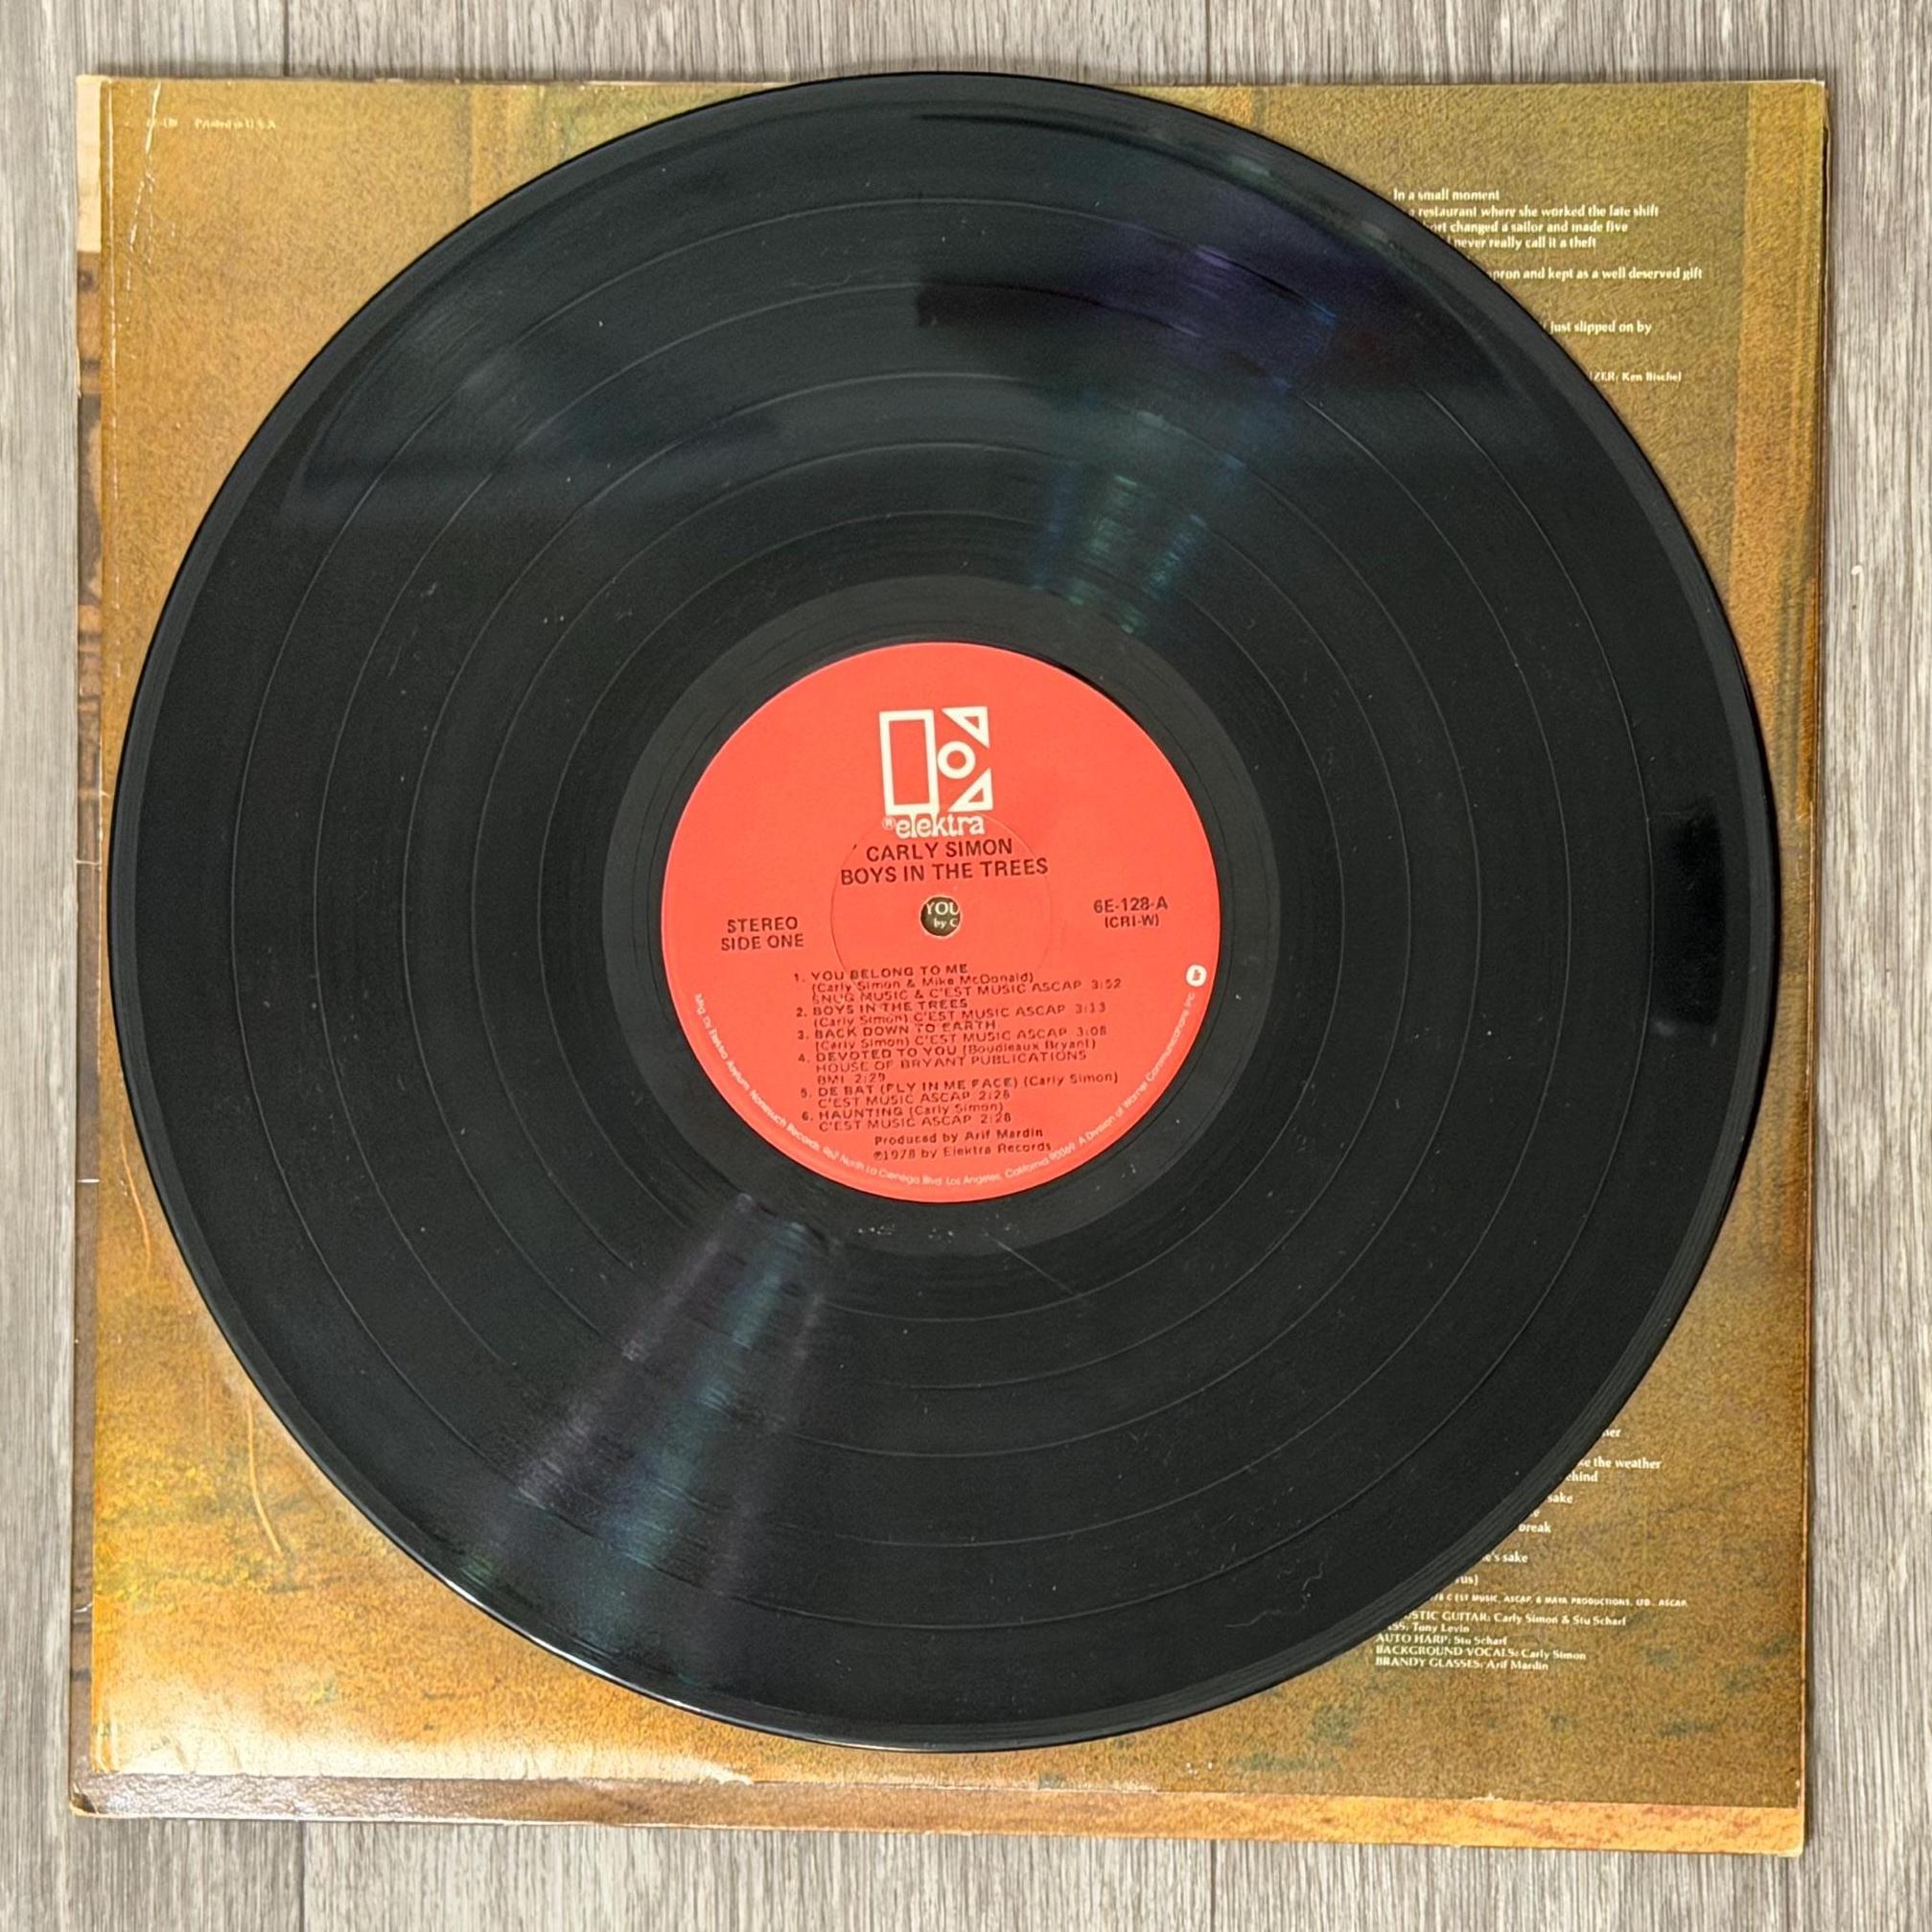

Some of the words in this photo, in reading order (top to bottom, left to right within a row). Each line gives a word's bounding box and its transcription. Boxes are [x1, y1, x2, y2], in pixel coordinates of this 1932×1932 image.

[1393, 188, 1405, 200] In
[1408, 192, 1415, 200] a
[1418, 188, 1450, 200] small
[1452, 189, 1500, 200] moment
[1418, 206, 1477, 218] restaurant
[1480, 204, 1517, 218] where
[1519, 204, 1538, 217] she
[1541, 204, 1585, 217] worked
[1588, 204, 1607, 217] the
[1609, 204, 1631, 217] late
[1633, 204, 1659, 218] shift
[1450, 221, 1499, 235] changed
[1511, 221, 1544, 232] sailor
[1547, 221, 1569, 233] and
[1571, 221, 1603, 233] made
[1606, 221, 1628, 233] five
[1454, 238, 1486, 248] never
[1489, 236, 1522, 250] really
[1525, 236, 1546, 248] call
[1548, 237, 1556, 248] it
[1559, 240, 1567, 248] a
[1569, 236, 1596, 248] theft
[1523, 267, 1545, 279] and
[1548, 267, 1573, 282] kept
[1575, 269, 1589, 279] as
[1592, 269, 1598, 279] a
[1601, 267, 1625, 279] well
[1628, 267, 1680, 279] deserved
[1683, 267, 1703, 281] gift
[1550, 321, 1571, 335] just
[1573, 320, 1616, 335] slipped
[1618, 324, 1633, 333] on
[1637, 320, 1652, 335] by
[1622, 372, 1642, 382] Ken
[896, 813, 985, 839] elektra
[866, 842, 939, 862] CARLY
[945, 838, 1013, 858] SIMON
[841, 866, 897, 885] BOYS
[903, 865, 924, 882] IN
[931, 862, 973, 880] THE
[979, 857, 1049, 875] TREES
[926, 901, 960, 916] YOU
[1093, 896, 1168, 914] 6E-128-A
[727, 917, 798, 934] STEREO
[934, 918, 947, 929] by
[1105, 913, 1159, 928] (CRI-W)
[721, 936, 761, 951] SIDE
[767, 933, 803, 948] ONE
[811, 970, 845, 982] YOU
[850, 966, 914, 980] BELONG
[920, 965, 941, 976] TO
[945, 964, 967, 974] ME
[812, 982, 851, 994] (Carly
[857, 980, 900, 991] Simon
[906, 979, 916, 988] &
[922, 977, 954, 988] Mike
[960, 972, 1034, 987] McDonald)
[860, 989, 908, 1002] MUSIC
[914, 989, 923, 999] &
[929, 986, 971, 998] C'EST
[977, 984, 1026, 996] MUSIC
[1032, 980, 1082, 992] ASCAP
[813, 1005, 854, 1016] BOYS
[860, 1003, 876, 1013] IN
[881, 1001, 913, 1013] THE
[918, 998, 968, 1011] TREES
[814, 1015, 854, 1028] (Carly
[859, 1013, 908, 1026] Simon)
[914, 1011, 956, 1022] C'EST
[962, 1007, 1010, 1020] MUSIC
[1015, 1004, 1065, 1016] ASCAP
[815, 1028, 857, 1039] BACK
[863, 1025, 909, 1036] DOWN
[915, 1023, 936, 1034] TO
[943, 1020, 996, 1032] EARTH
[816, 1039, 855, 1052] (Carly
[861, 1036, 910, 1049] Simon)
[915, 1034, 957, 1045] C'EST
[964, 1030, 1011, 1042] MUSIC
[1016, 1028, 1067, 1039] ASCAP
[816, 1049, 892, 1062] DEVOTED
[897, 1048, 918, 1059] TO
[923, 1046, 957, 1057] YOU
[816, 1061, 869, 1074] HOUSE
[874, 1059, 893, 1071] OF
[900, 1057, 964, 1069] BRYANT
[971, 1050, 1086, 1066] PUBLICATIONS
[819, 1086, 838, 1097] DE
[844, 1084, 874, 1096] BAT
[880, 1082, 916, 1095] (FLY
[922, 1081, 939, 1091] IN
[943, 1080, 966, 1090] ME
[971, 1077, 1018, 1089] FACE)
[1024, 1075, 1064, 1087] (Carly
[1070, 1072, 1118, 1083] Simon)
[818, 1097, 860, 1108] C'EST
[866, 1094, 914, 1106] MUSIC
[920, 1090, 970, 1103] ASCAP
[819, 1106, 903, 1120] HAUNTING
[910, 1105, 949, 1118] (Carly
[955, 1102, 1004, 1114] Simon)
[819, 1120, 861, 1132] C'EST
[867, 1117, 916, 1129] MUSIC
[921, 1114, 971, 1127] ASCAP
[874, 1132, 937, 1146] Produced
[943, 1132, 958, 1143] by
[965, 1129, 990, 1141] Arif
[996, 1127, 1043, 1139] Mardin
[920, 1150, 937, 1159] by
[943, 1144, 991, 1156] Elektra
[997, 1142, 1052, 1153] Records
[1594, 1456, 1612, 1468] the
[1615, 1457, 1663, 1470] weather
[1566, 1471, 1598, 1482] ehind
[1547, 1492, 1573, 1504] sake
[1502, 1551, 1528, 1564] sake
[1494, 1613, 1523, 1624] Carly
[1525, 1614, 1558, 1623] Simon
[1561, 1616, 1570, 1624] &
[1572, 1615, 1591, 1625] Stu
[1441, 1623, 1470, 1633] Levin
[1376, 1633, 1411, 1642] AUTO
[1414, 1634, 1451, 1644] HARP:
[1454, 1636, 1471, 1645] Stu
[1376, 1644, 1463, 1656] BACKGROUND
[1466, 1647, 1519, 1658] VOCALS:
[1522, 1648, 1549, 1660] Carly
[1553, 1650, 1586, 1660] Simon
[1376, 1657, 1427, 1666] BRANDY
[1430, 1658, 1482, 1668] GLASSES:
[1486, 1659, 1507, 1669] Arif
[1510, 1660, 1549, 1670] Mardin
